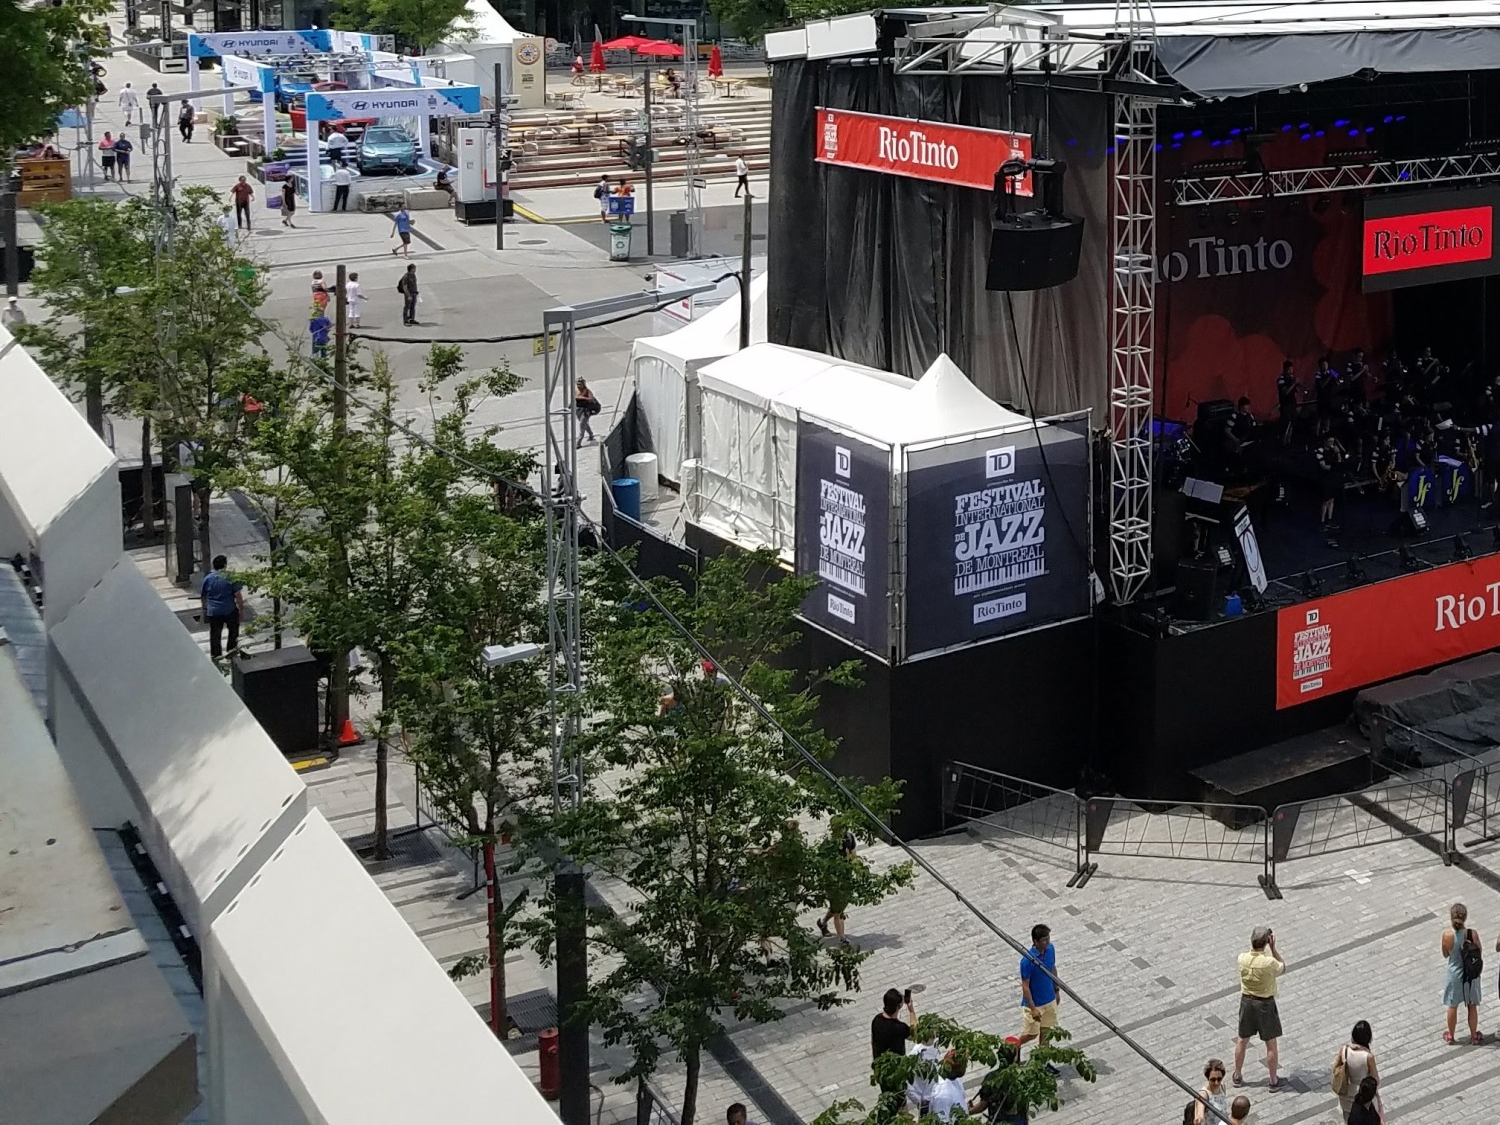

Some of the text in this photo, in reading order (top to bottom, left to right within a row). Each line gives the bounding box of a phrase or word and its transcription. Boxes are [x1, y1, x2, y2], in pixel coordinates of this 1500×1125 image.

[238, 39, 279, 47] HYUNDAI
[372, 99, 419, 109] HYUNDAI
[989, 451, 1012, 472] TD
[820, 478, 866, 514] FESTIVAL
[955, 478, 1046, 515] FESTIVAL
[955, 495, 1046, 527] INTERNATIONAL
[820, 511, 866, 562] JAZZ
[954, 508, 1045, 562] DE JAZZ
[820, 544, 829, 560] DE
[955, 561, 974, 577] DE
[1294, 624, 1332, 643] FESTIVAL
[1293, 638, 1331, 664] JAZZ
